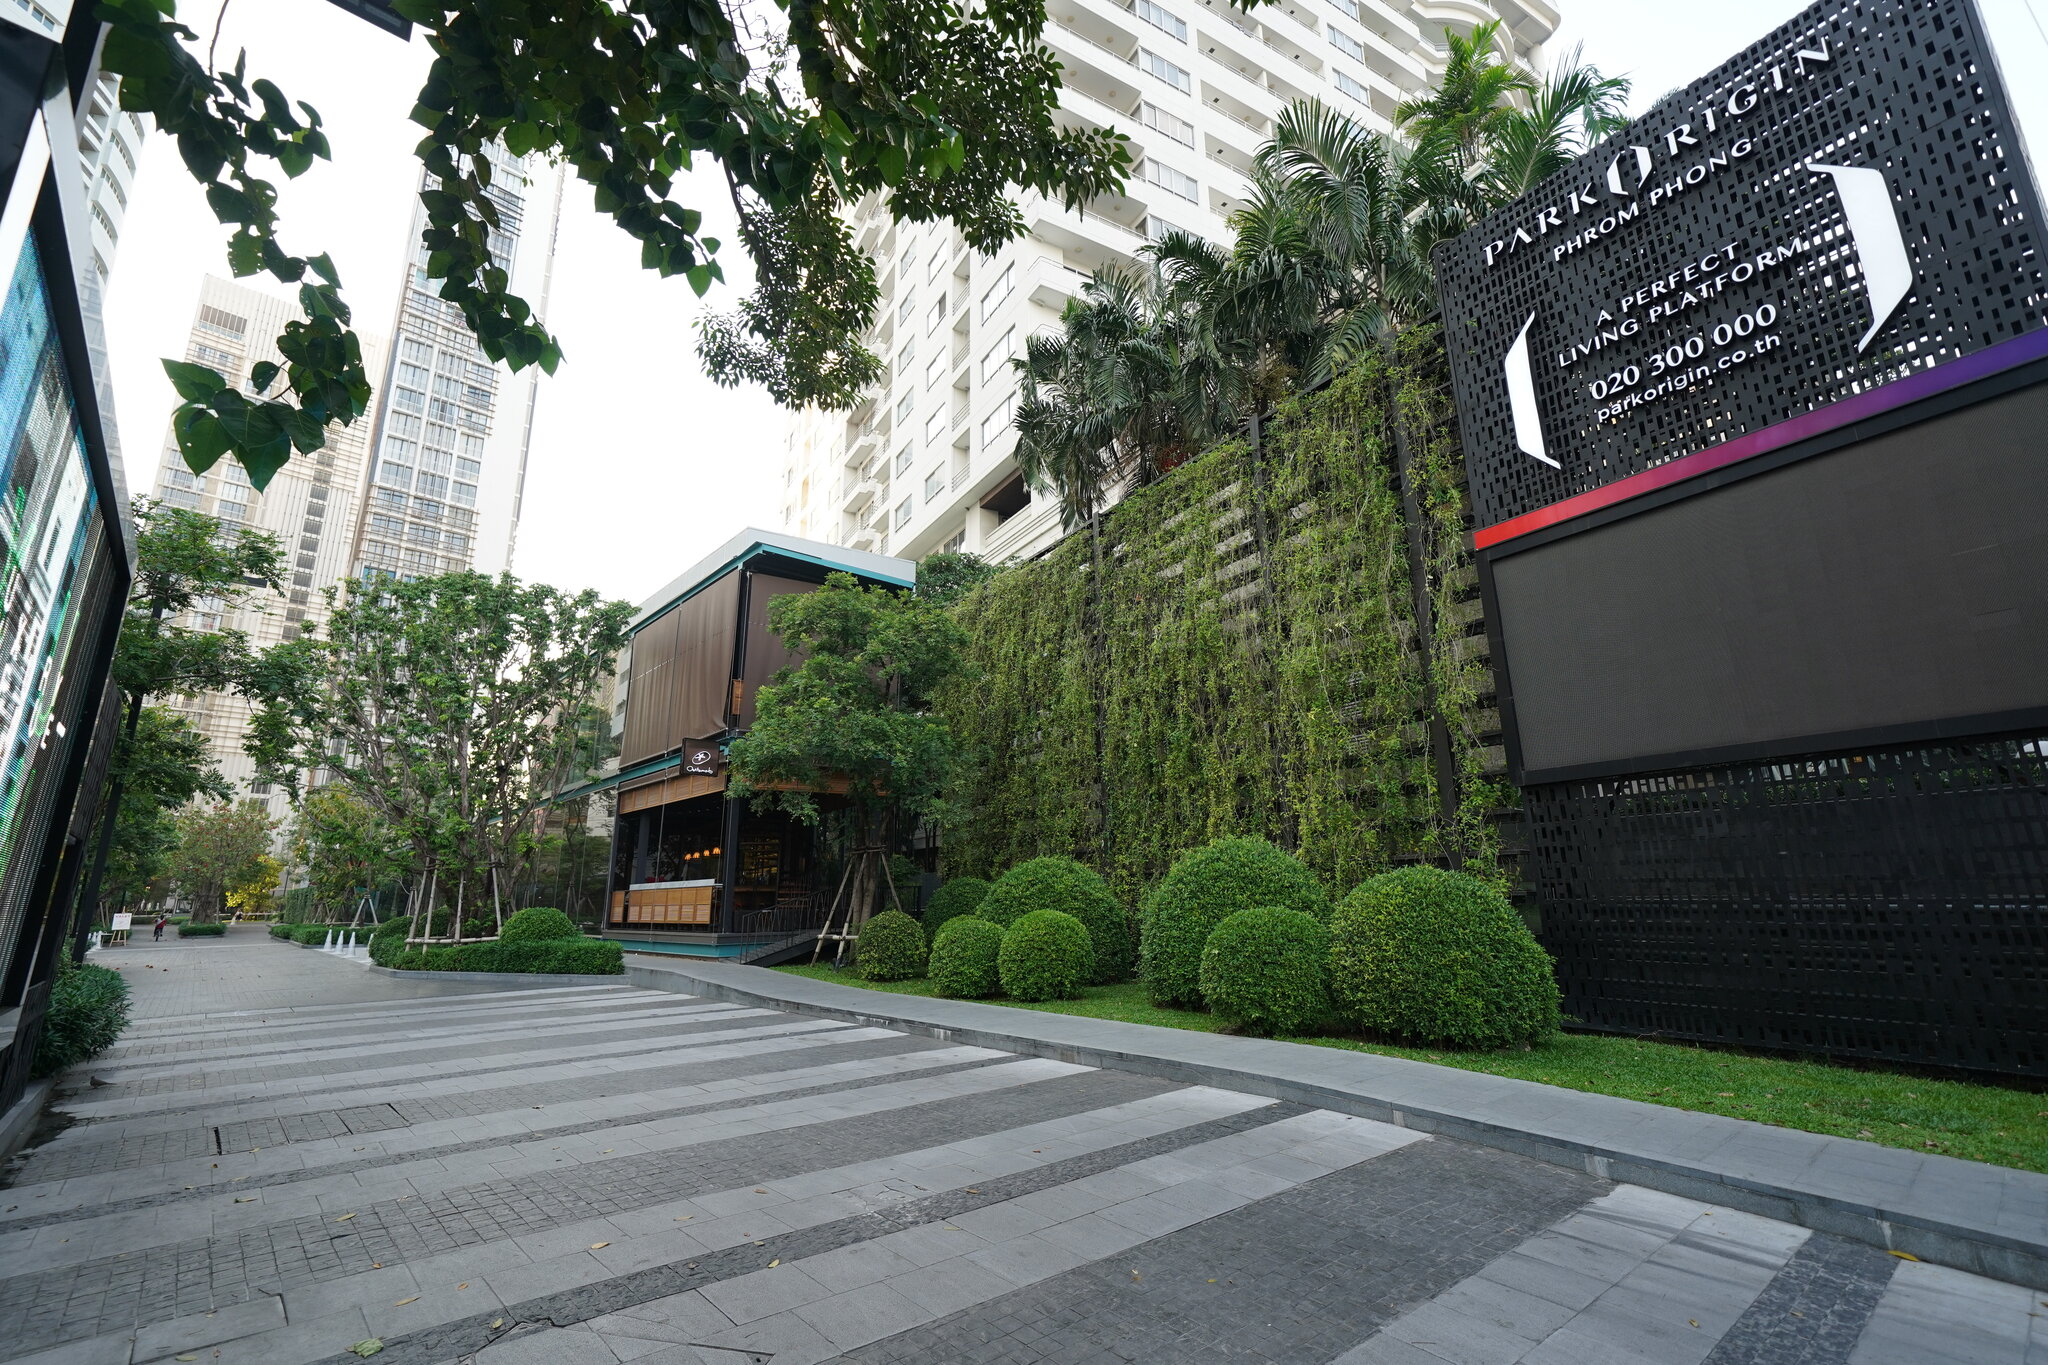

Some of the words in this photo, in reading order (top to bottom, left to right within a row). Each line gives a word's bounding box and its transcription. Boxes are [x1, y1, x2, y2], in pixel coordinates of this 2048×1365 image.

[1483, 182, 1598, 266] PARK
[1553, 202, 1639, 262] PHROM
[1650, 138, 1753, 205] PHONG
[1558, 318, 1640, 368] LIVING
[1649, 237, 1804, 323] PLATFORM
[1597, 309, 1612, 326] A
[1621, 241, 1739, 313] PERFECT
[1591, 365, 1641, 400] 020
[1649, 336, 1705, 377] 300
[1713, 303, 1777, 346] 000
[1597, 334, 1781, 424] parkorigin.co.th
